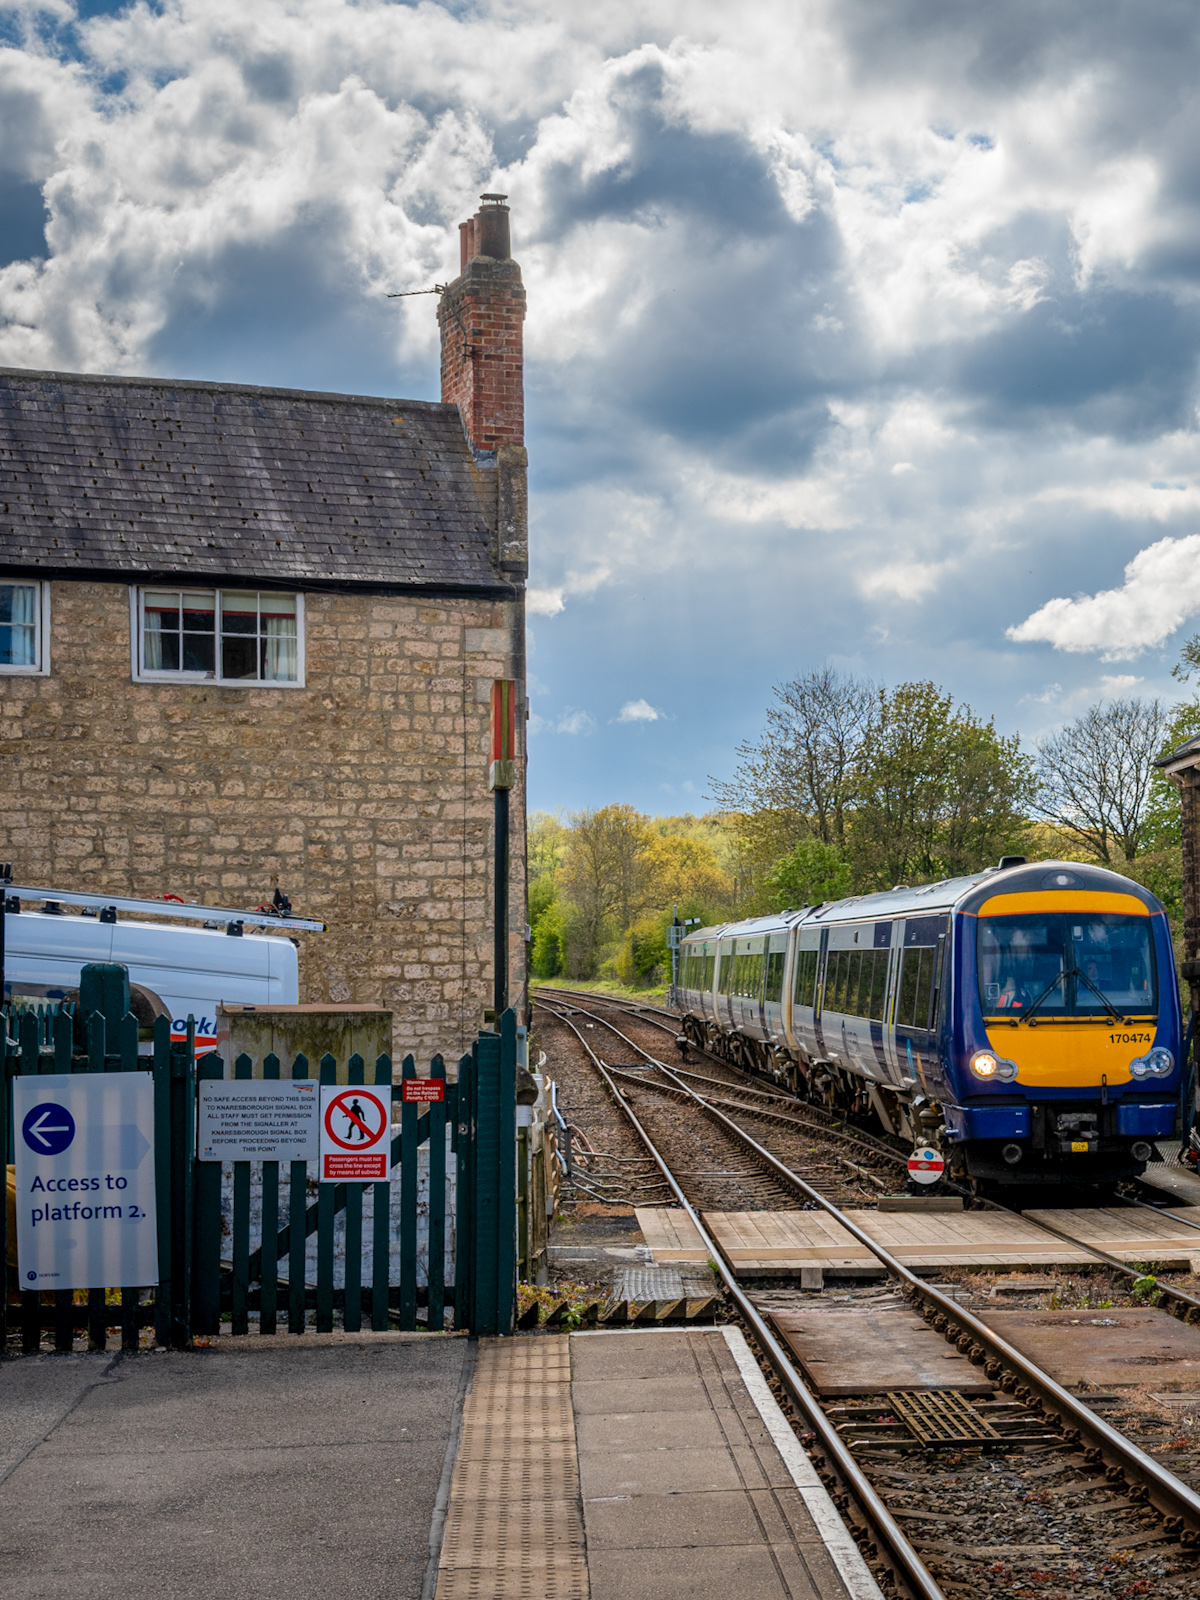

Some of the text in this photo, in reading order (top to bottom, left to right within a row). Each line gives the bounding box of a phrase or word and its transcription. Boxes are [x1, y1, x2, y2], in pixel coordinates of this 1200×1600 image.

[1109, 1033, 1151, 1044] 170474
[30, 1174, 128, 1193] Access to
[31, 1201, 146, 1227] platform 2.
